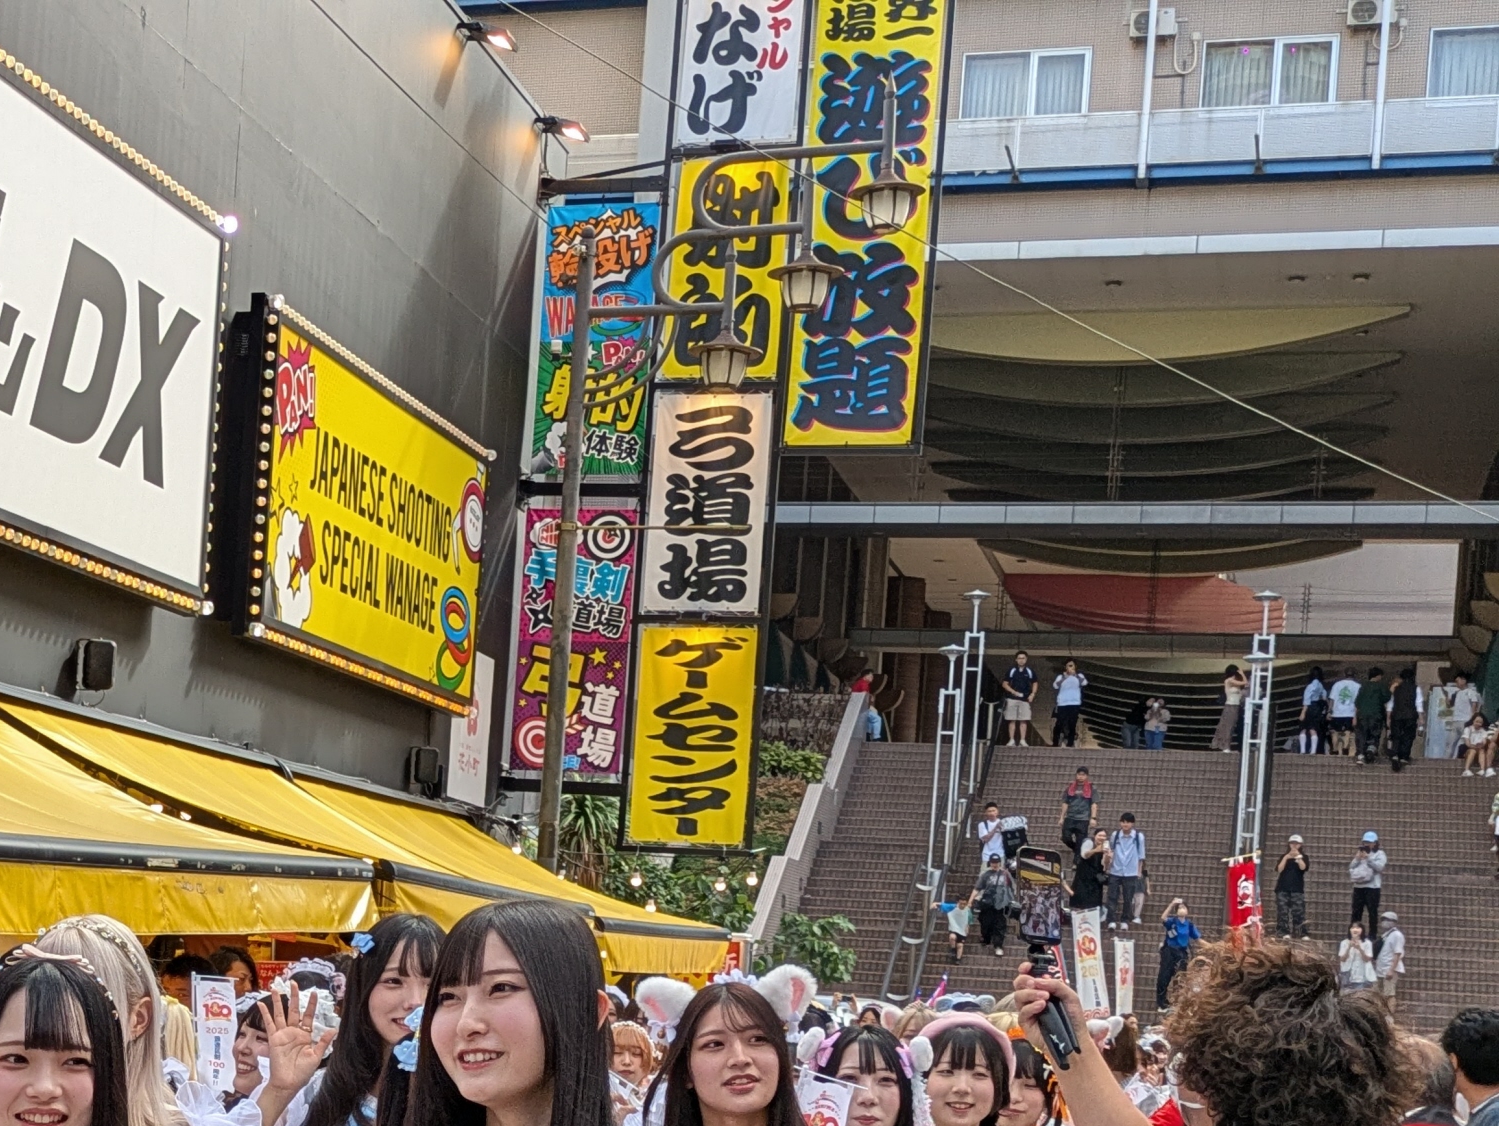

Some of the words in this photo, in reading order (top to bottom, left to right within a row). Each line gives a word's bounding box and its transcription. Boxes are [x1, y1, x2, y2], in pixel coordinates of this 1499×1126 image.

[825, 0, 876, 42] 場
[792, 50, 932, 431] 遊び放題
[276, 362, 316, 434] PAN!
[584, 430, 641, 464] 体験
[310, 426, 388, 528] JAPANESE
[387, 472, 452, 563] SHOOTING
[657, 405, 755, 603] 弓道場
[319, 520, 381, 609] SPECIAL
[385, 552, 439, 634] WANAGE
[576, 681, 621, 768] 道場
[647, 636, 749, 837] ゲームセンター
[206, 1026, 229, 1035] 2025
[208, 1060, 226, 1069] 100
